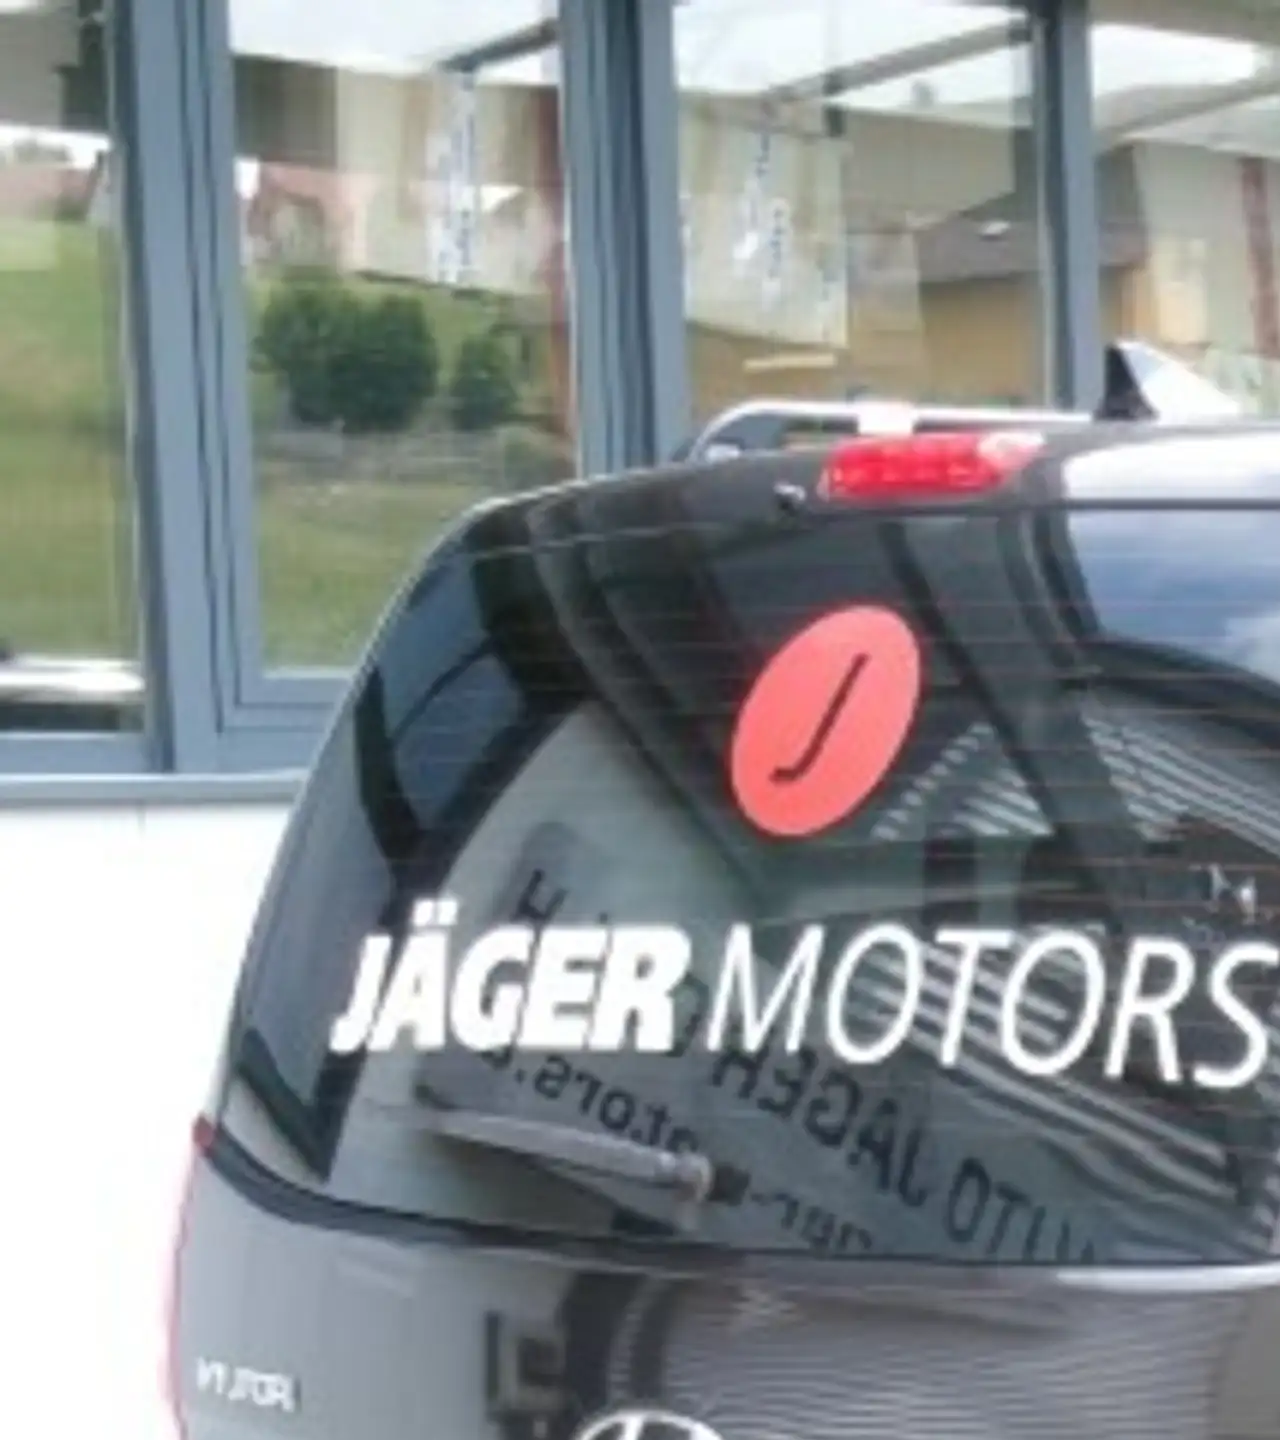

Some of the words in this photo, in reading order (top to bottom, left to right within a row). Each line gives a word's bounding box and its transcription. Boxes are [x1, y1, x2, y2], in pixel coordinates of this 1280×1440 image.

[769, 653, 870, 785] J
[330, 897, 692, 1053] JÄGER
[705, 922, 1280, 1089] MOTORS
